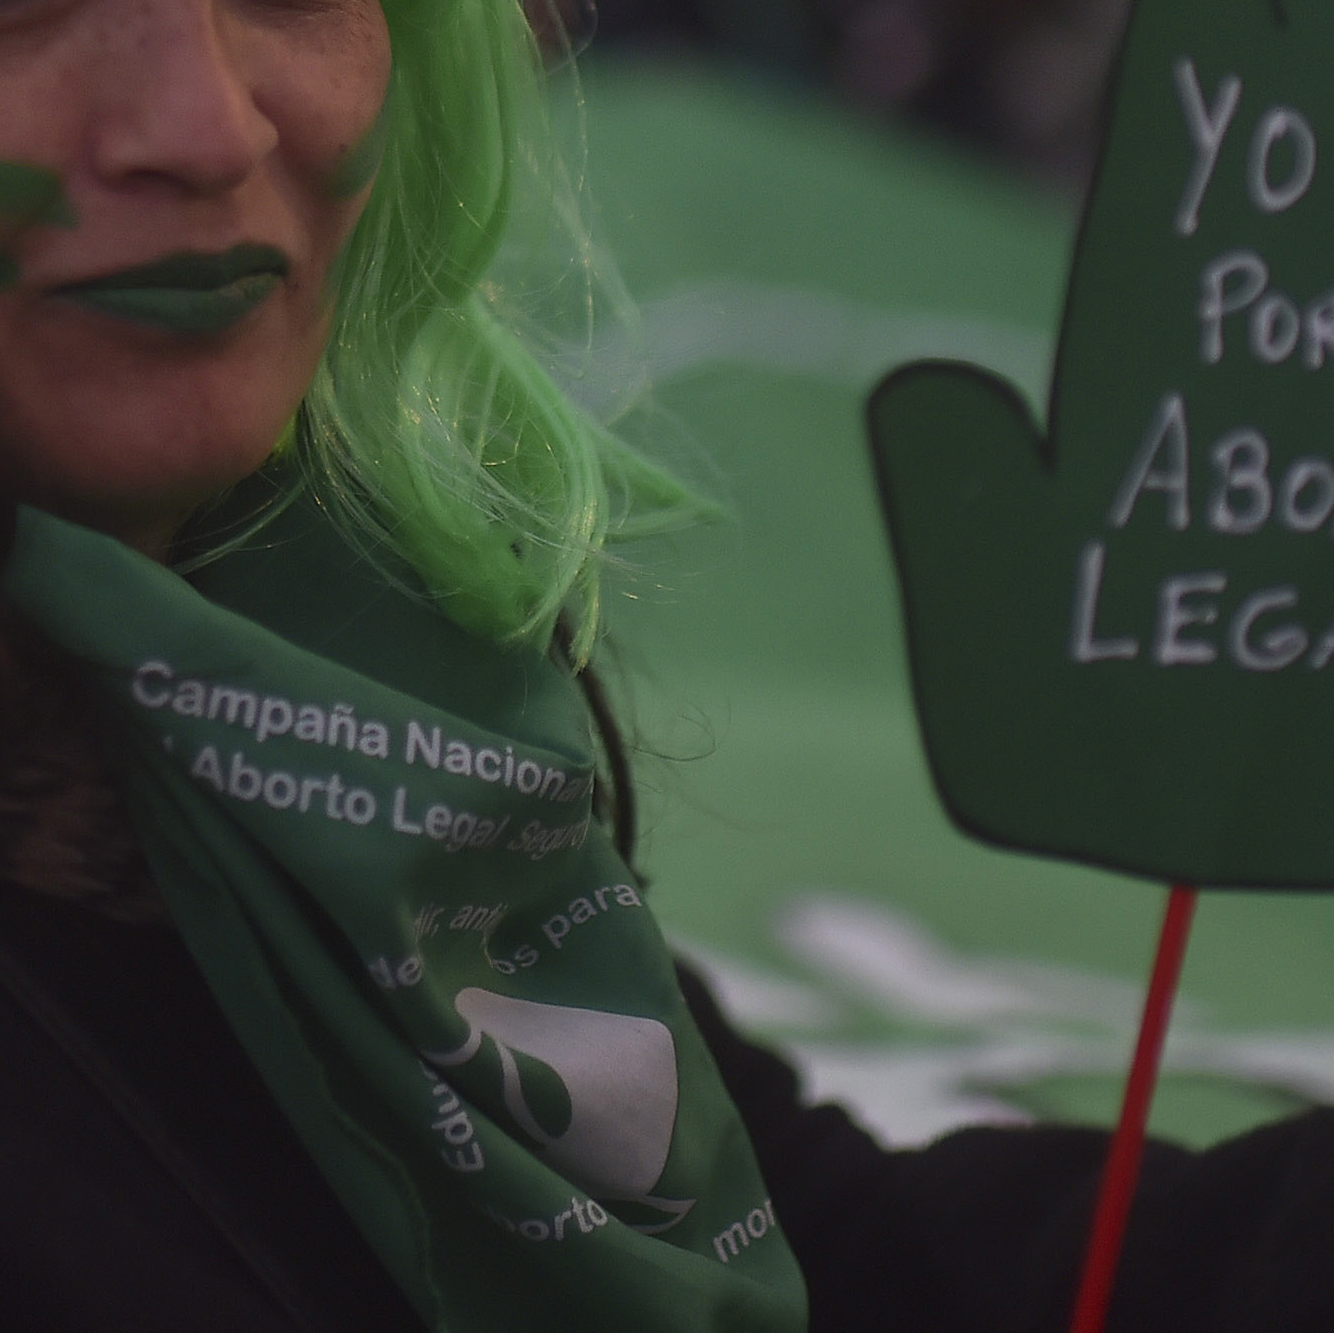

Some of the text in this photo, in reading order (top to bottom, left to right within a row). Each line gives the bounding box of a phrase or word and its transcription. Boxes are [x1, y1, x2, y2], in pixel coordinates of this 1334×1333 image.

[1174, 57, 1318, 237] YO
[130, 660, 389, 760] Campaña
[191, 743, 377, 828] Aborto
[391, 785, 509, 853] Legal
[541, 882, 644, 950] para
